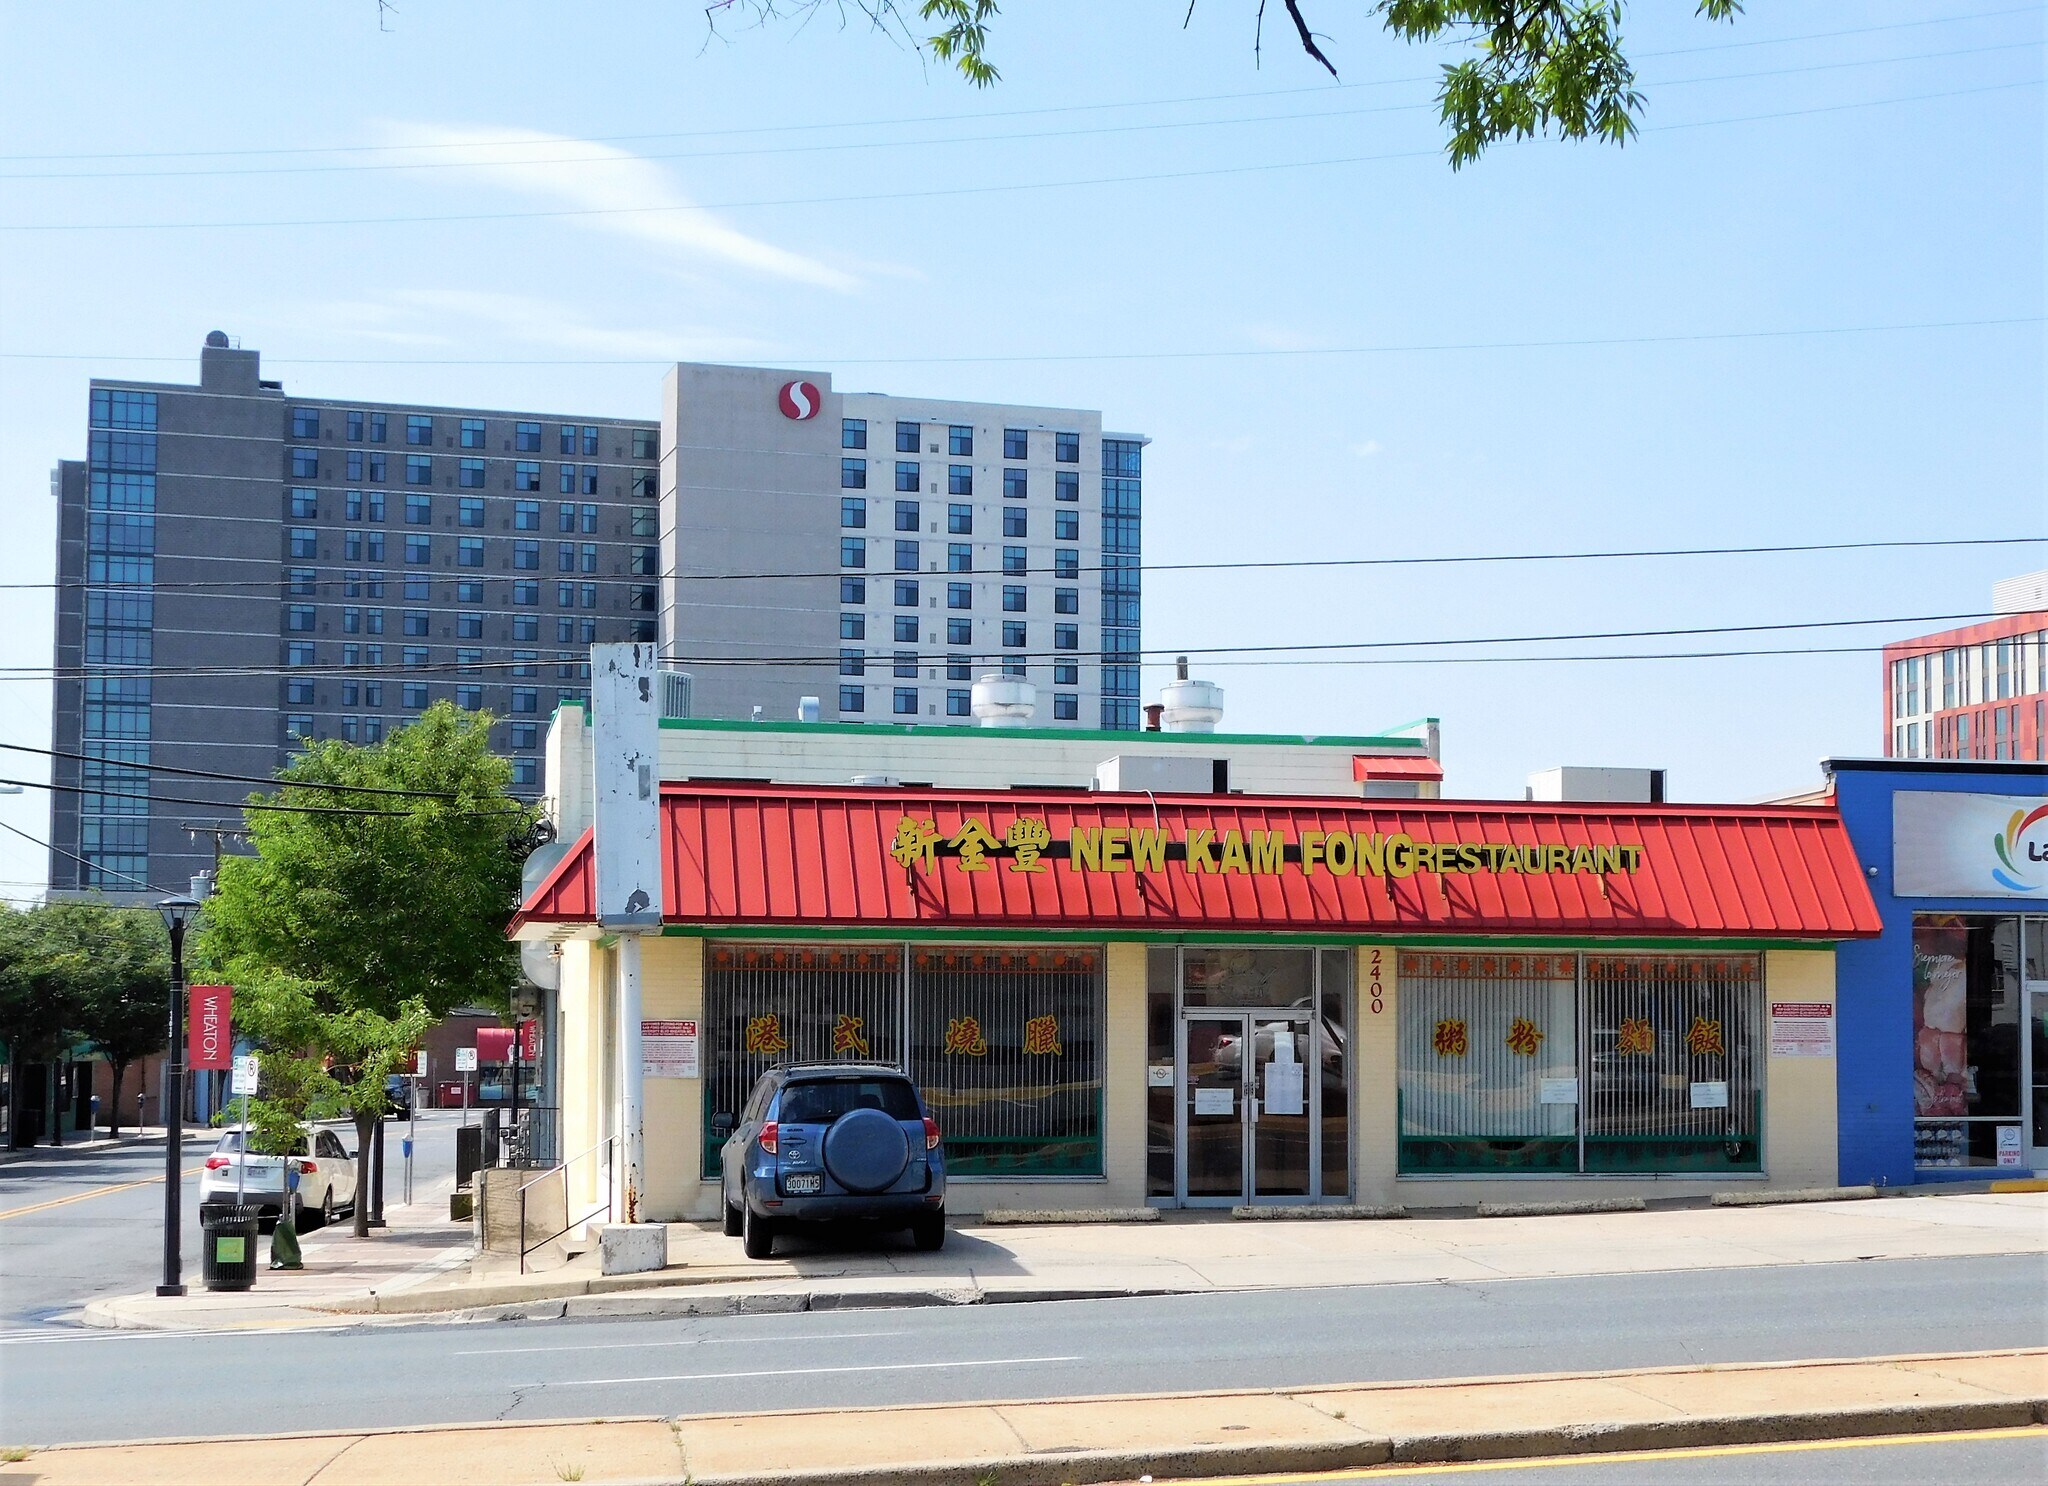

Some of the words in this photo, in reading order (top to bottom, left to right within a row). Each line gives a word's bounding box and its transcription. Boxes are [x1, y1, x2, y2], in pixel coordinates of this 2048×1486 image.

[890, 816, 1051, 876] 新金豐
[1070, 827, 1168, 872] NEW
[1186, 829, 1284, 874] KAM
[1301, 831, 1414, 878] FONG
[1413, 842, 1645, 875] RESTAURANT
[1370, 950, 1383, 1014] 2400
[203, 996, 218, 1060] WHEATON
